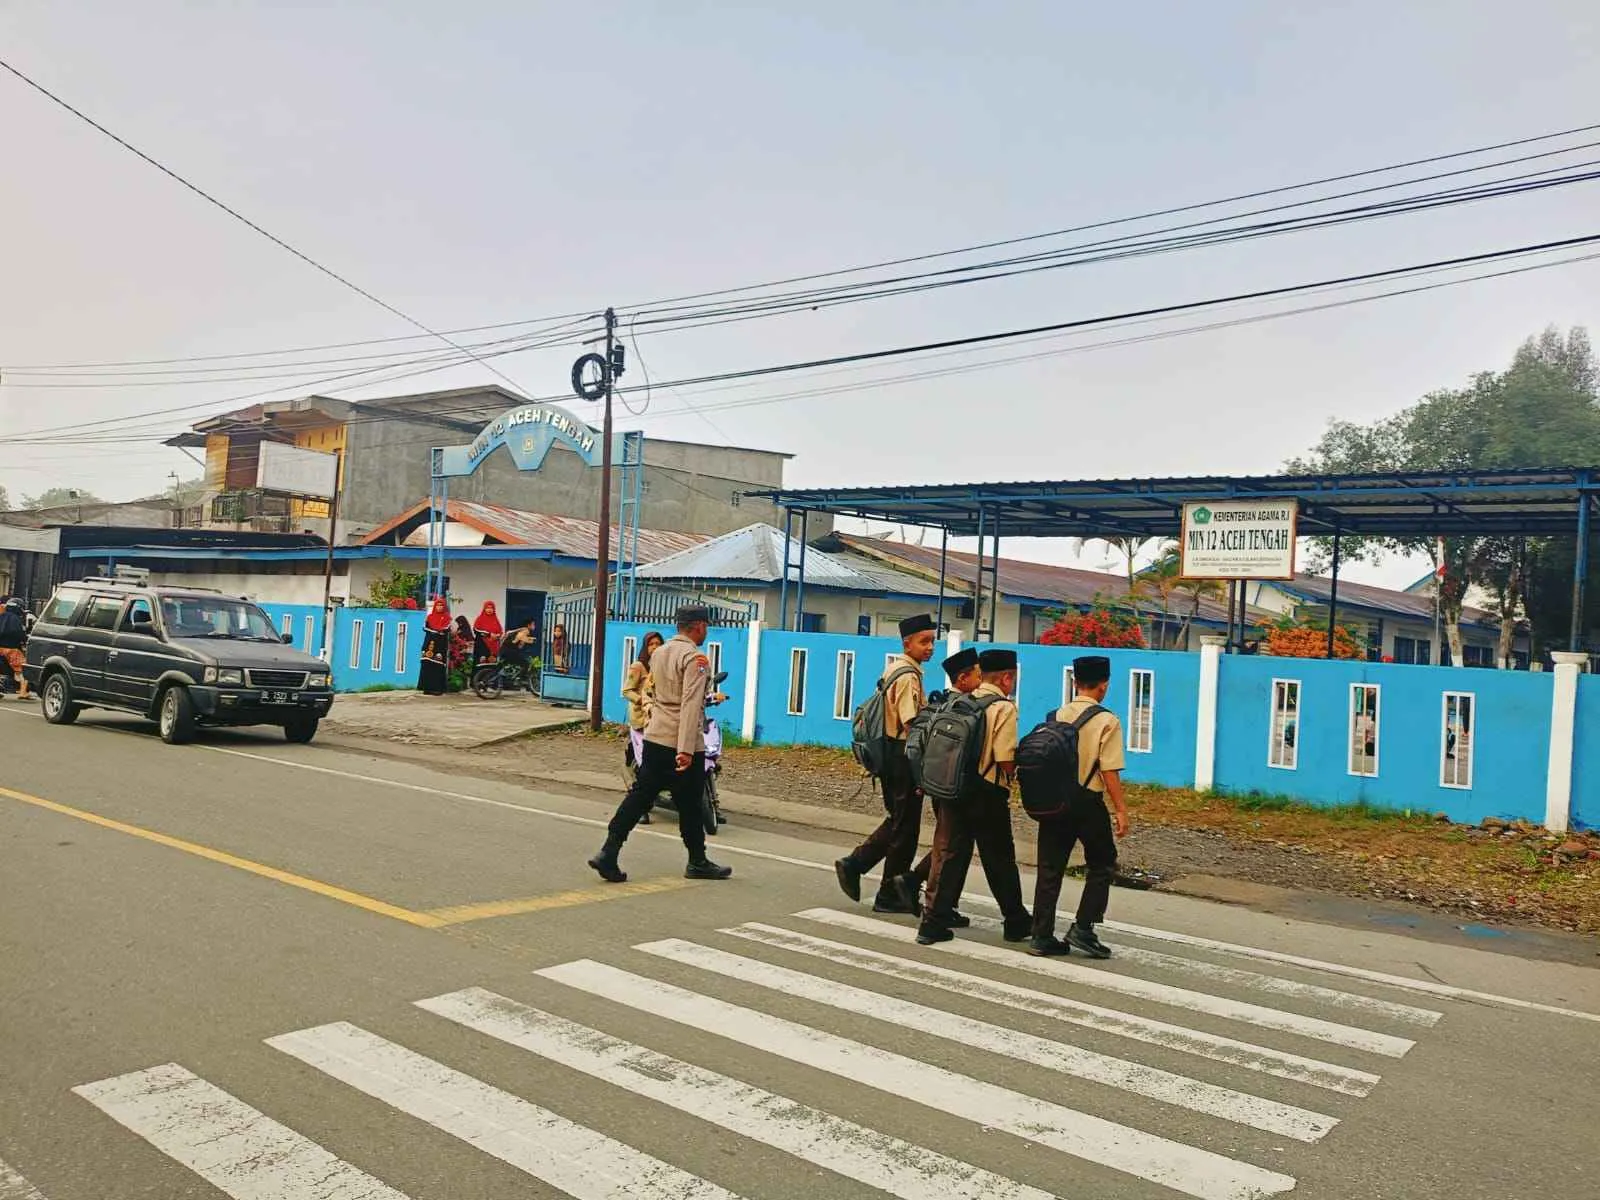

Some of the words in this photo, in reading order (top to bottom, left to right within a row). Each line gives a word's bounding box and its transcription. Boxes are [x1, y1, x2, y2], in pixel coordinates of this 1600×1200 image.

[508, 409, 541, 428] ACEH
[544, 410, 595, 452] TENGAH
[1213, 511, 1256, 522] KEMENTERIAN
[1257, 510, 1280, 521] AGAMA
[1188, 530, 1206, 551] MIN
[1207, 530, 1217, 550] 12
[1219, 529, 1246, 551] ACEH
[1248, 529, 1289, 550] TENGAH
